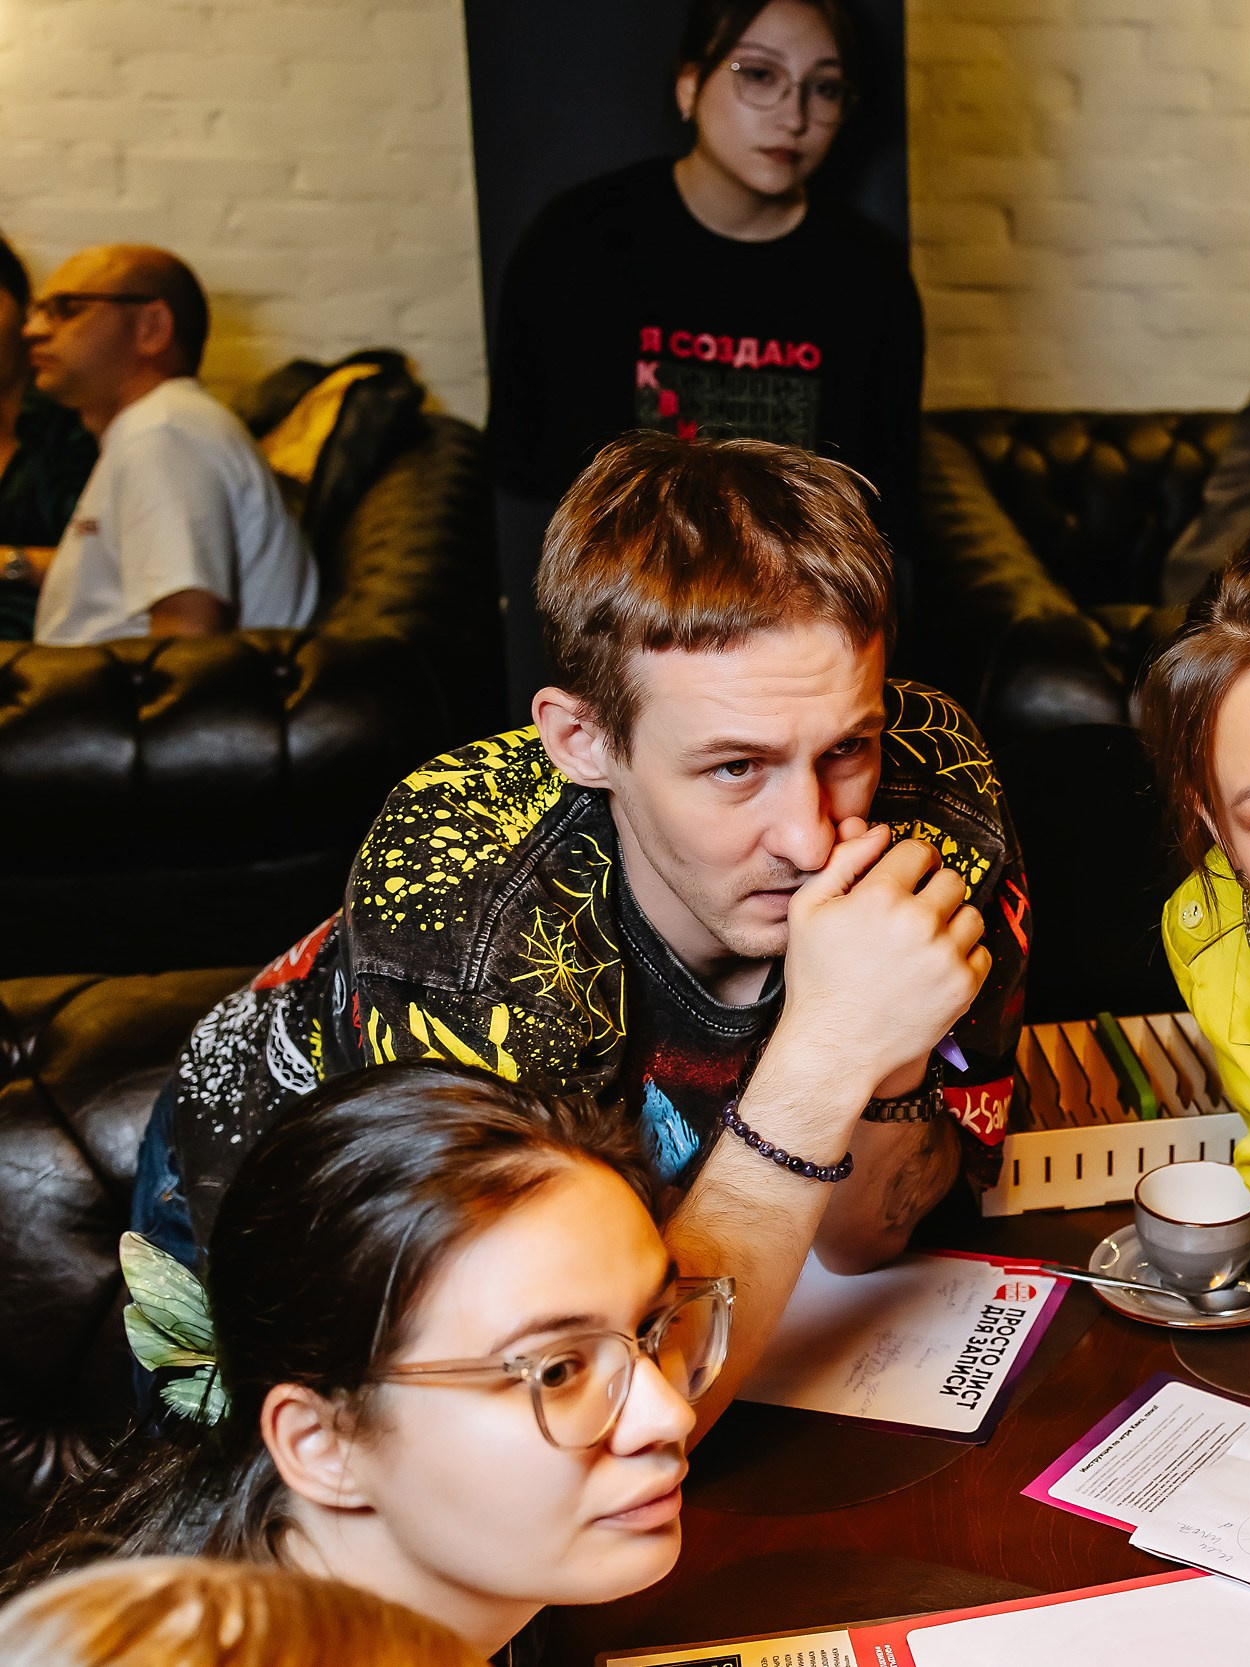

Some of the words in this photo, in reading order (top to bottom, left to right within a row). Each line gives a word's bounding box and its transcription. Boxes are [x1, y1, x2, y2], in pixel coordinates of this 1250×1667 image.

[668, 330, 822, 371] СОЗДАЮ
[974, 1303, 1006, 1334] ДЛЯ
[980, 1307, 1026, 1366] ПРОСТО
[939, 1336, 988, 1395] ЗАПИСИ
[956, 1365, 994, 1410] ЛИСТ
